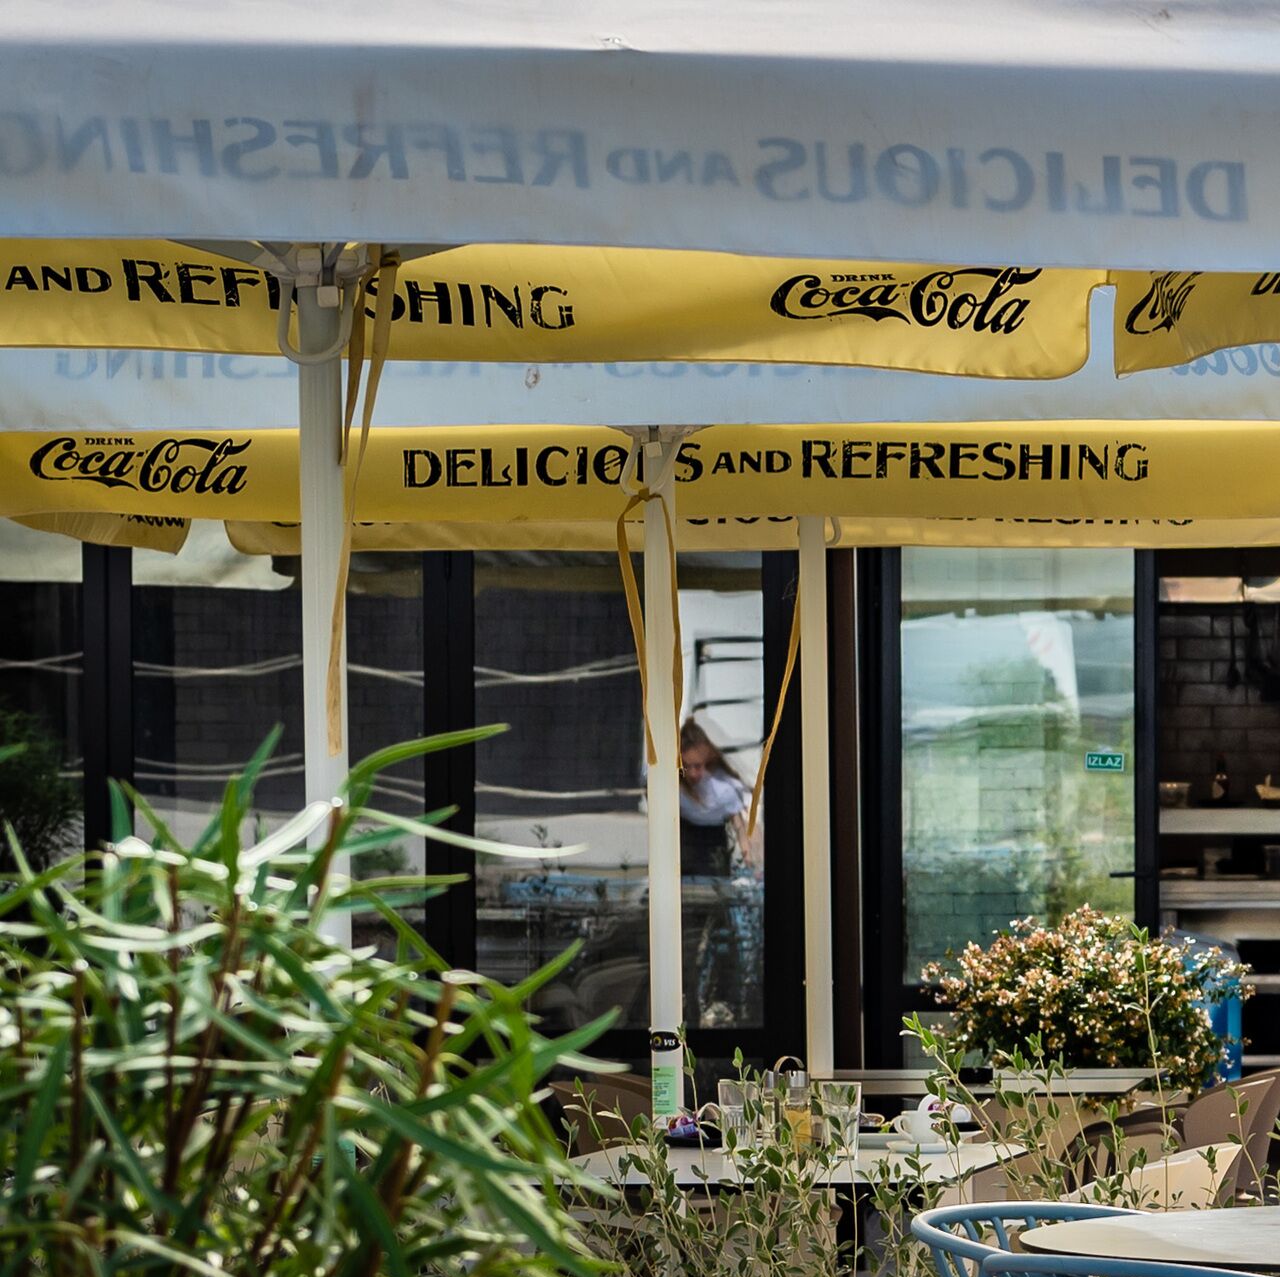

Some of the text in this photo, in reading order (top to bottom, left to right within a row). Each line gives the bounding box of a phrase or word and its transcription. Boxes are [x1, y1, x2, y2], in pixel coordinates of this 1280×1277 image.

[5, 258, 575, 330] AND REFSHING
[830, 273, 896, 283] DRINK
[770, 267, 1042, 335] Coca-Cola
[84, 436, 135, 446] DRINK
[711, 449, 793, 475] AND
[801, 439, 1150, 482] REFRESHING
[29, 436, 252, 495] Coca-Cola
[1088, 756, 1122, 767] IZLAZ
